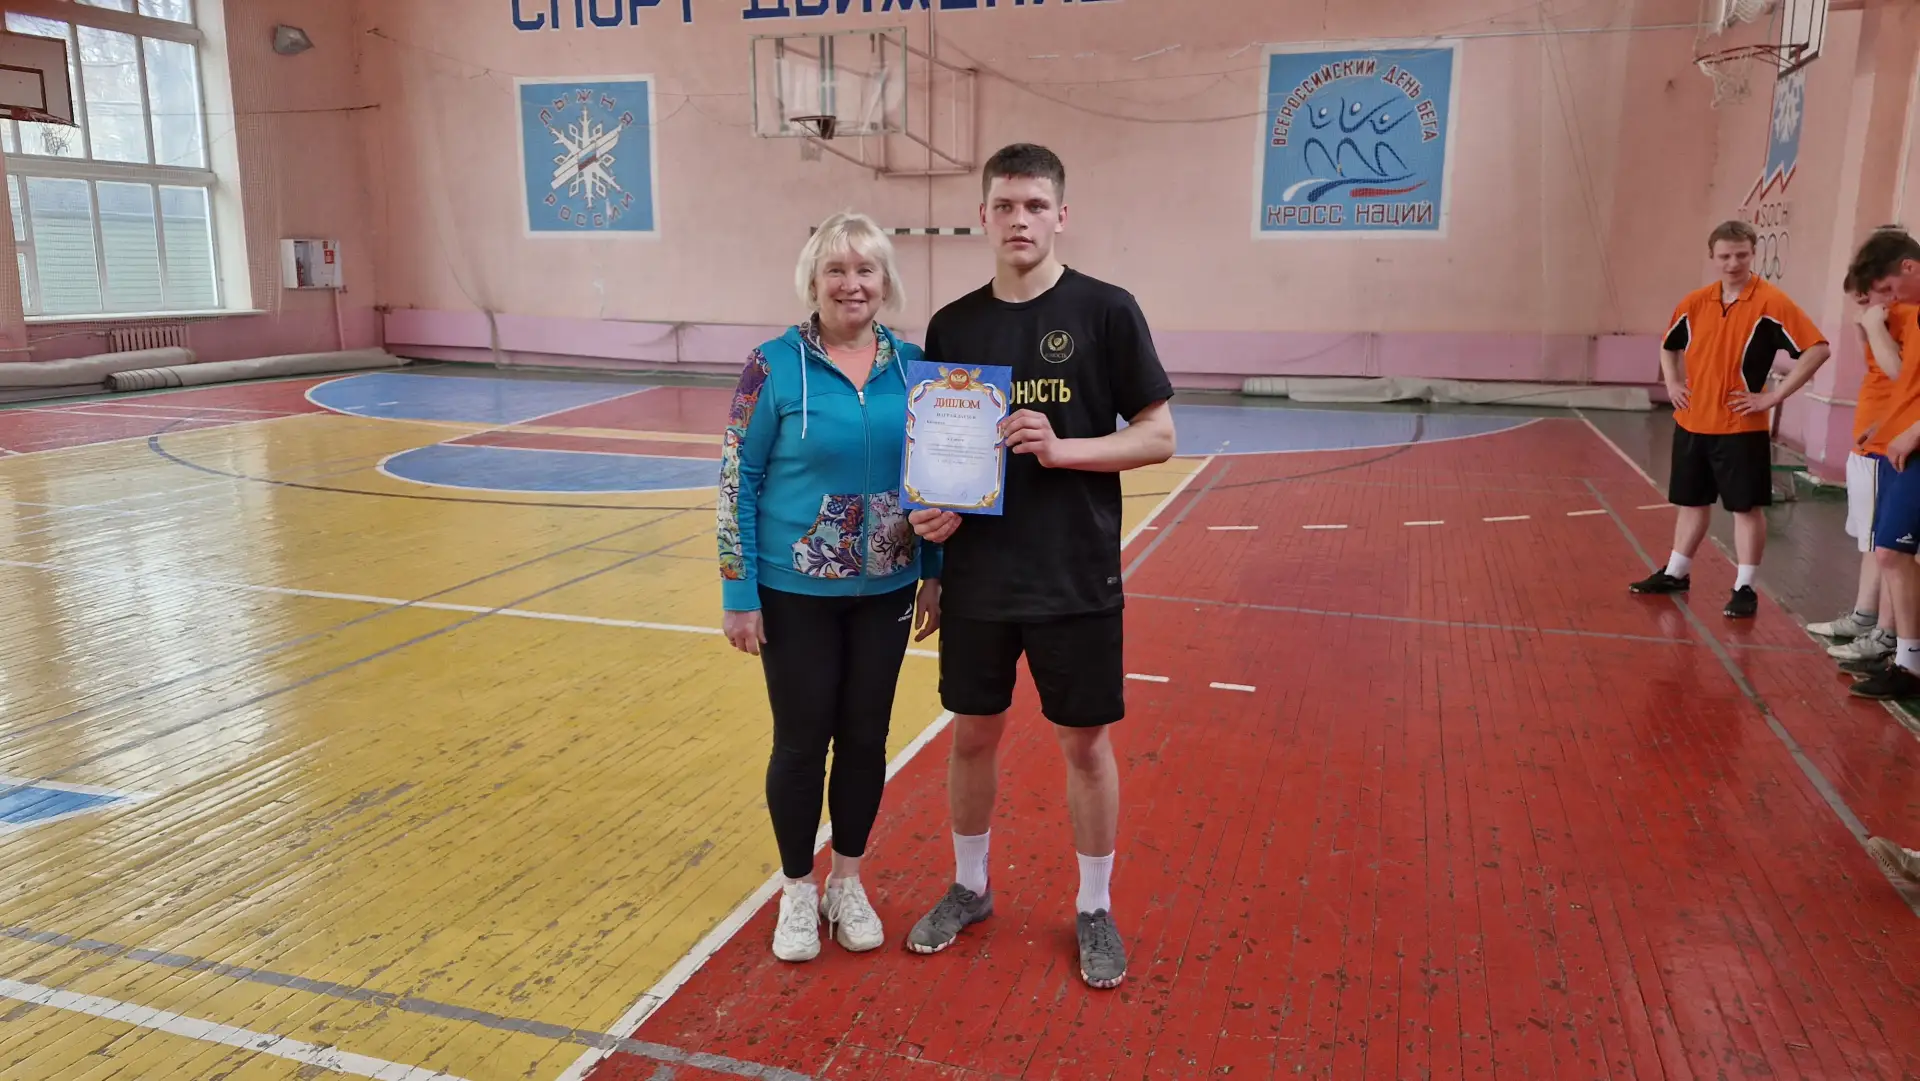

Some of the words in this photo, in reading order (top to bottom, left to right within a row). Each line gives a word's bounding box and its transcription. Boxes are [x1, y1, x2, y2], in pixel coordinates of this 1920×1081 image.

[1272, 58, 1376, 147] ВСЕРОССИЙСКИЙ
[1382, 66, 1422, 99] ДЕНЬ
[1416, 100, 1438, 142] БЕГА
[1267, 204, 1342, 225] КРОСС
[934, 398, 980, 409] ДИПЛОМ
